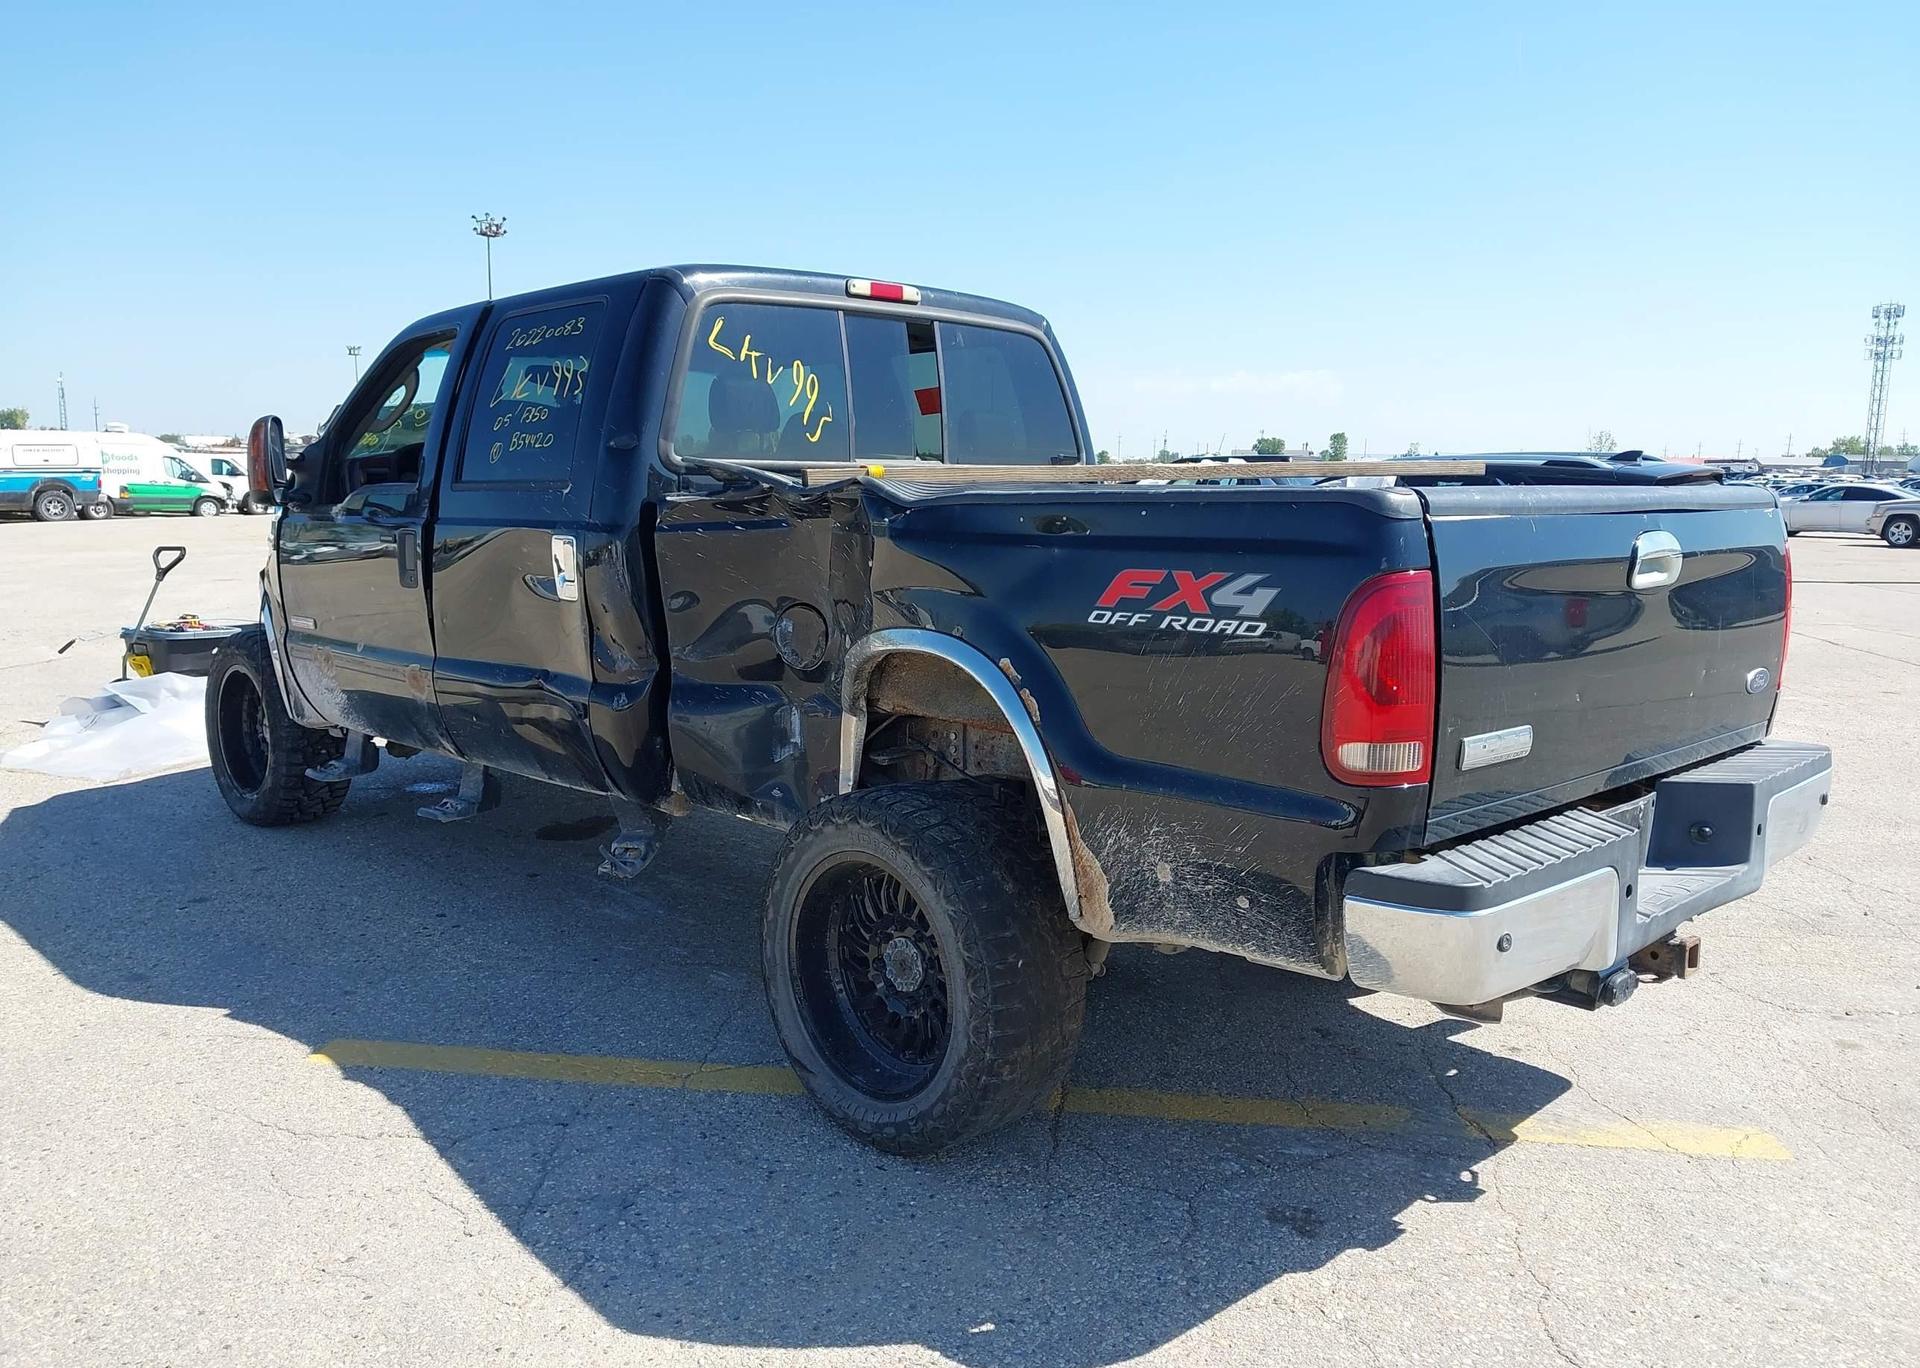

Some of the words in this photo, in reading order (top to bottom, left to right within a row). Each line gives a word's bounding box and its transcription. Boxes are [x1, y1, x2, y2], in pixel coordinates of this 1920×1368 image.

[1094, 568, 1282, 618] FX4
[1087, 609, 1151, 627] OFF
[1159, 615, 1268, 637] ROAD
